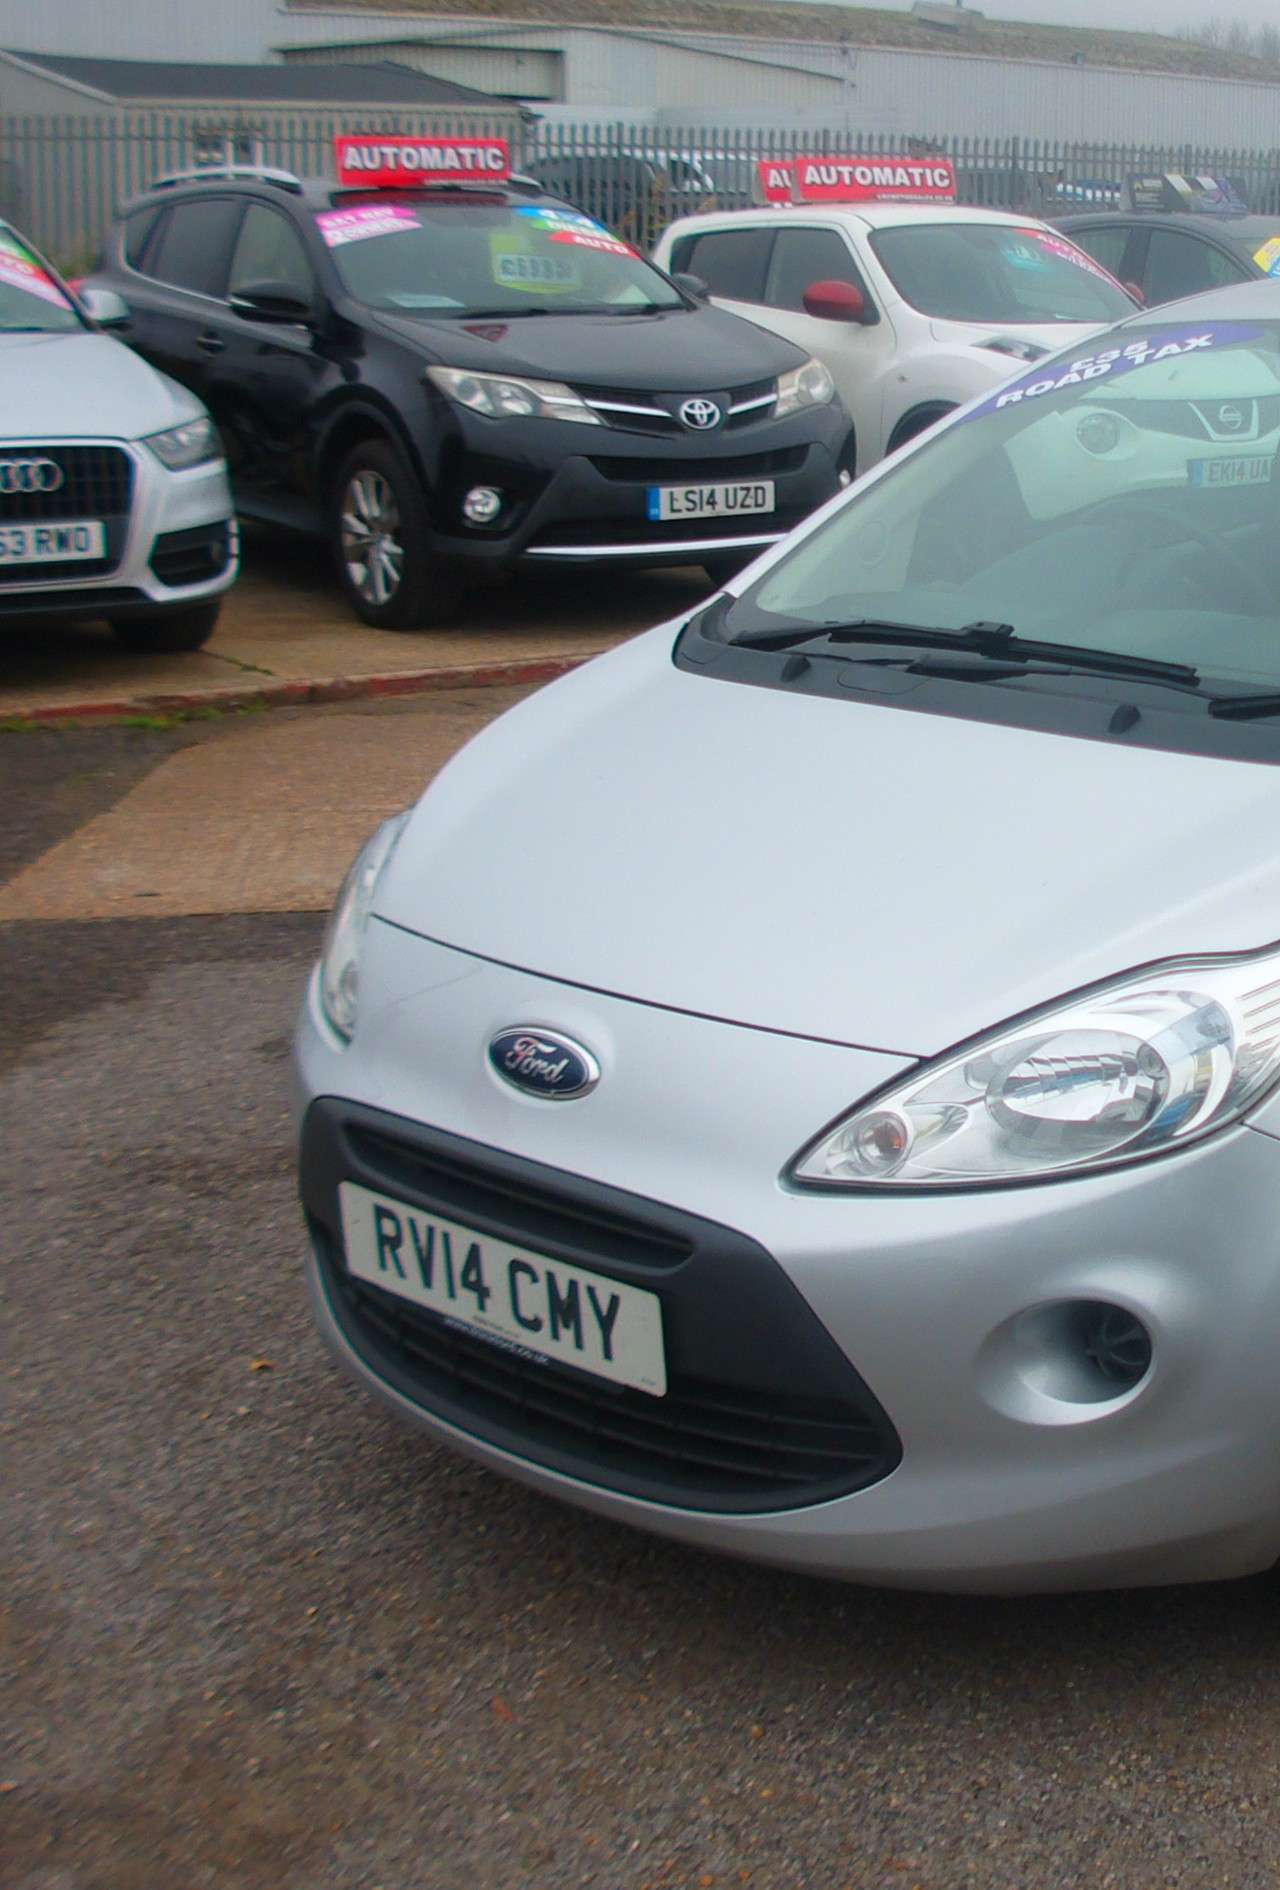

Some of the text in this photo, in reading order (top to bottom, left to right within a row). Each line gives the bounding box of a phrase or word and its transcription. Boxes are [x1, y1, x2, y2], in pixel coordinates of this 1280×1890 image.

[344, 144, 505, 171] AUTOMATIC
[804, 165, 950, 188] AUTOMATIC
[574, 235, 629, 254] AUTO
[996, 333, 1214, 408] ROAD TAX
[1209, 461, 1245, 482] EK14
[669, 485, 767, 513] LS14 UZD
[504, 1036, 570, 1083] Ford
[373, 1202, 491, 1313] RV14
[508, 1257, 621, 1362] CMY
